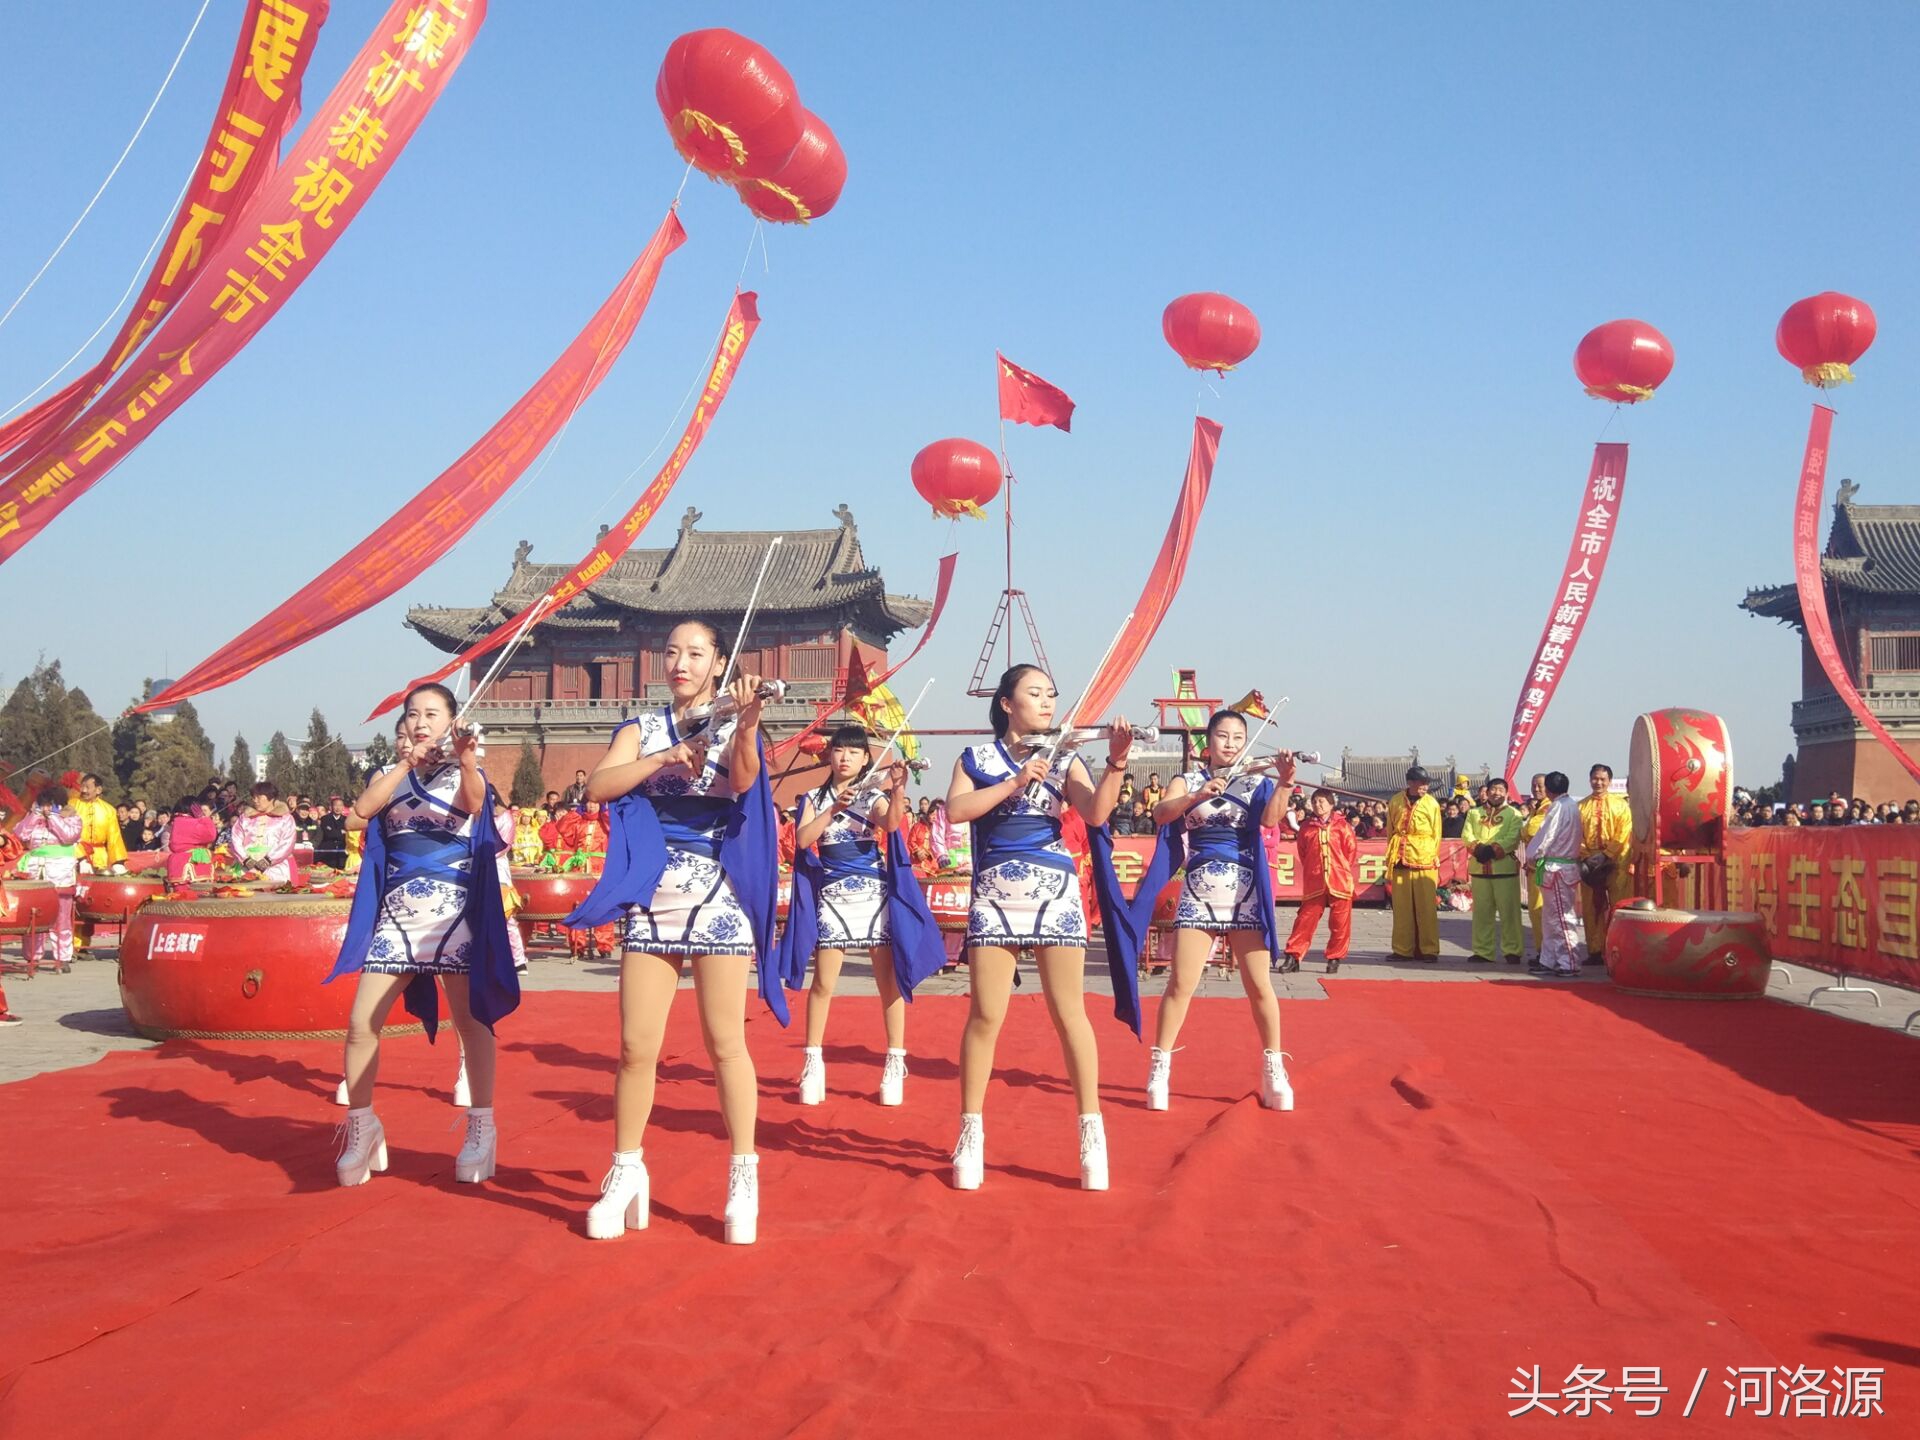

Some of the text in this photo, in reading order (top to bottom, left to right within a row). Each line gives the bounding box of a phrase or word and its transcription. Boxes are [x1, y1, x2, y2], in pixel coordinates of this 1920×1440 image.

[1532, 475, 1616, 683] 祝全市人民新春快乐
